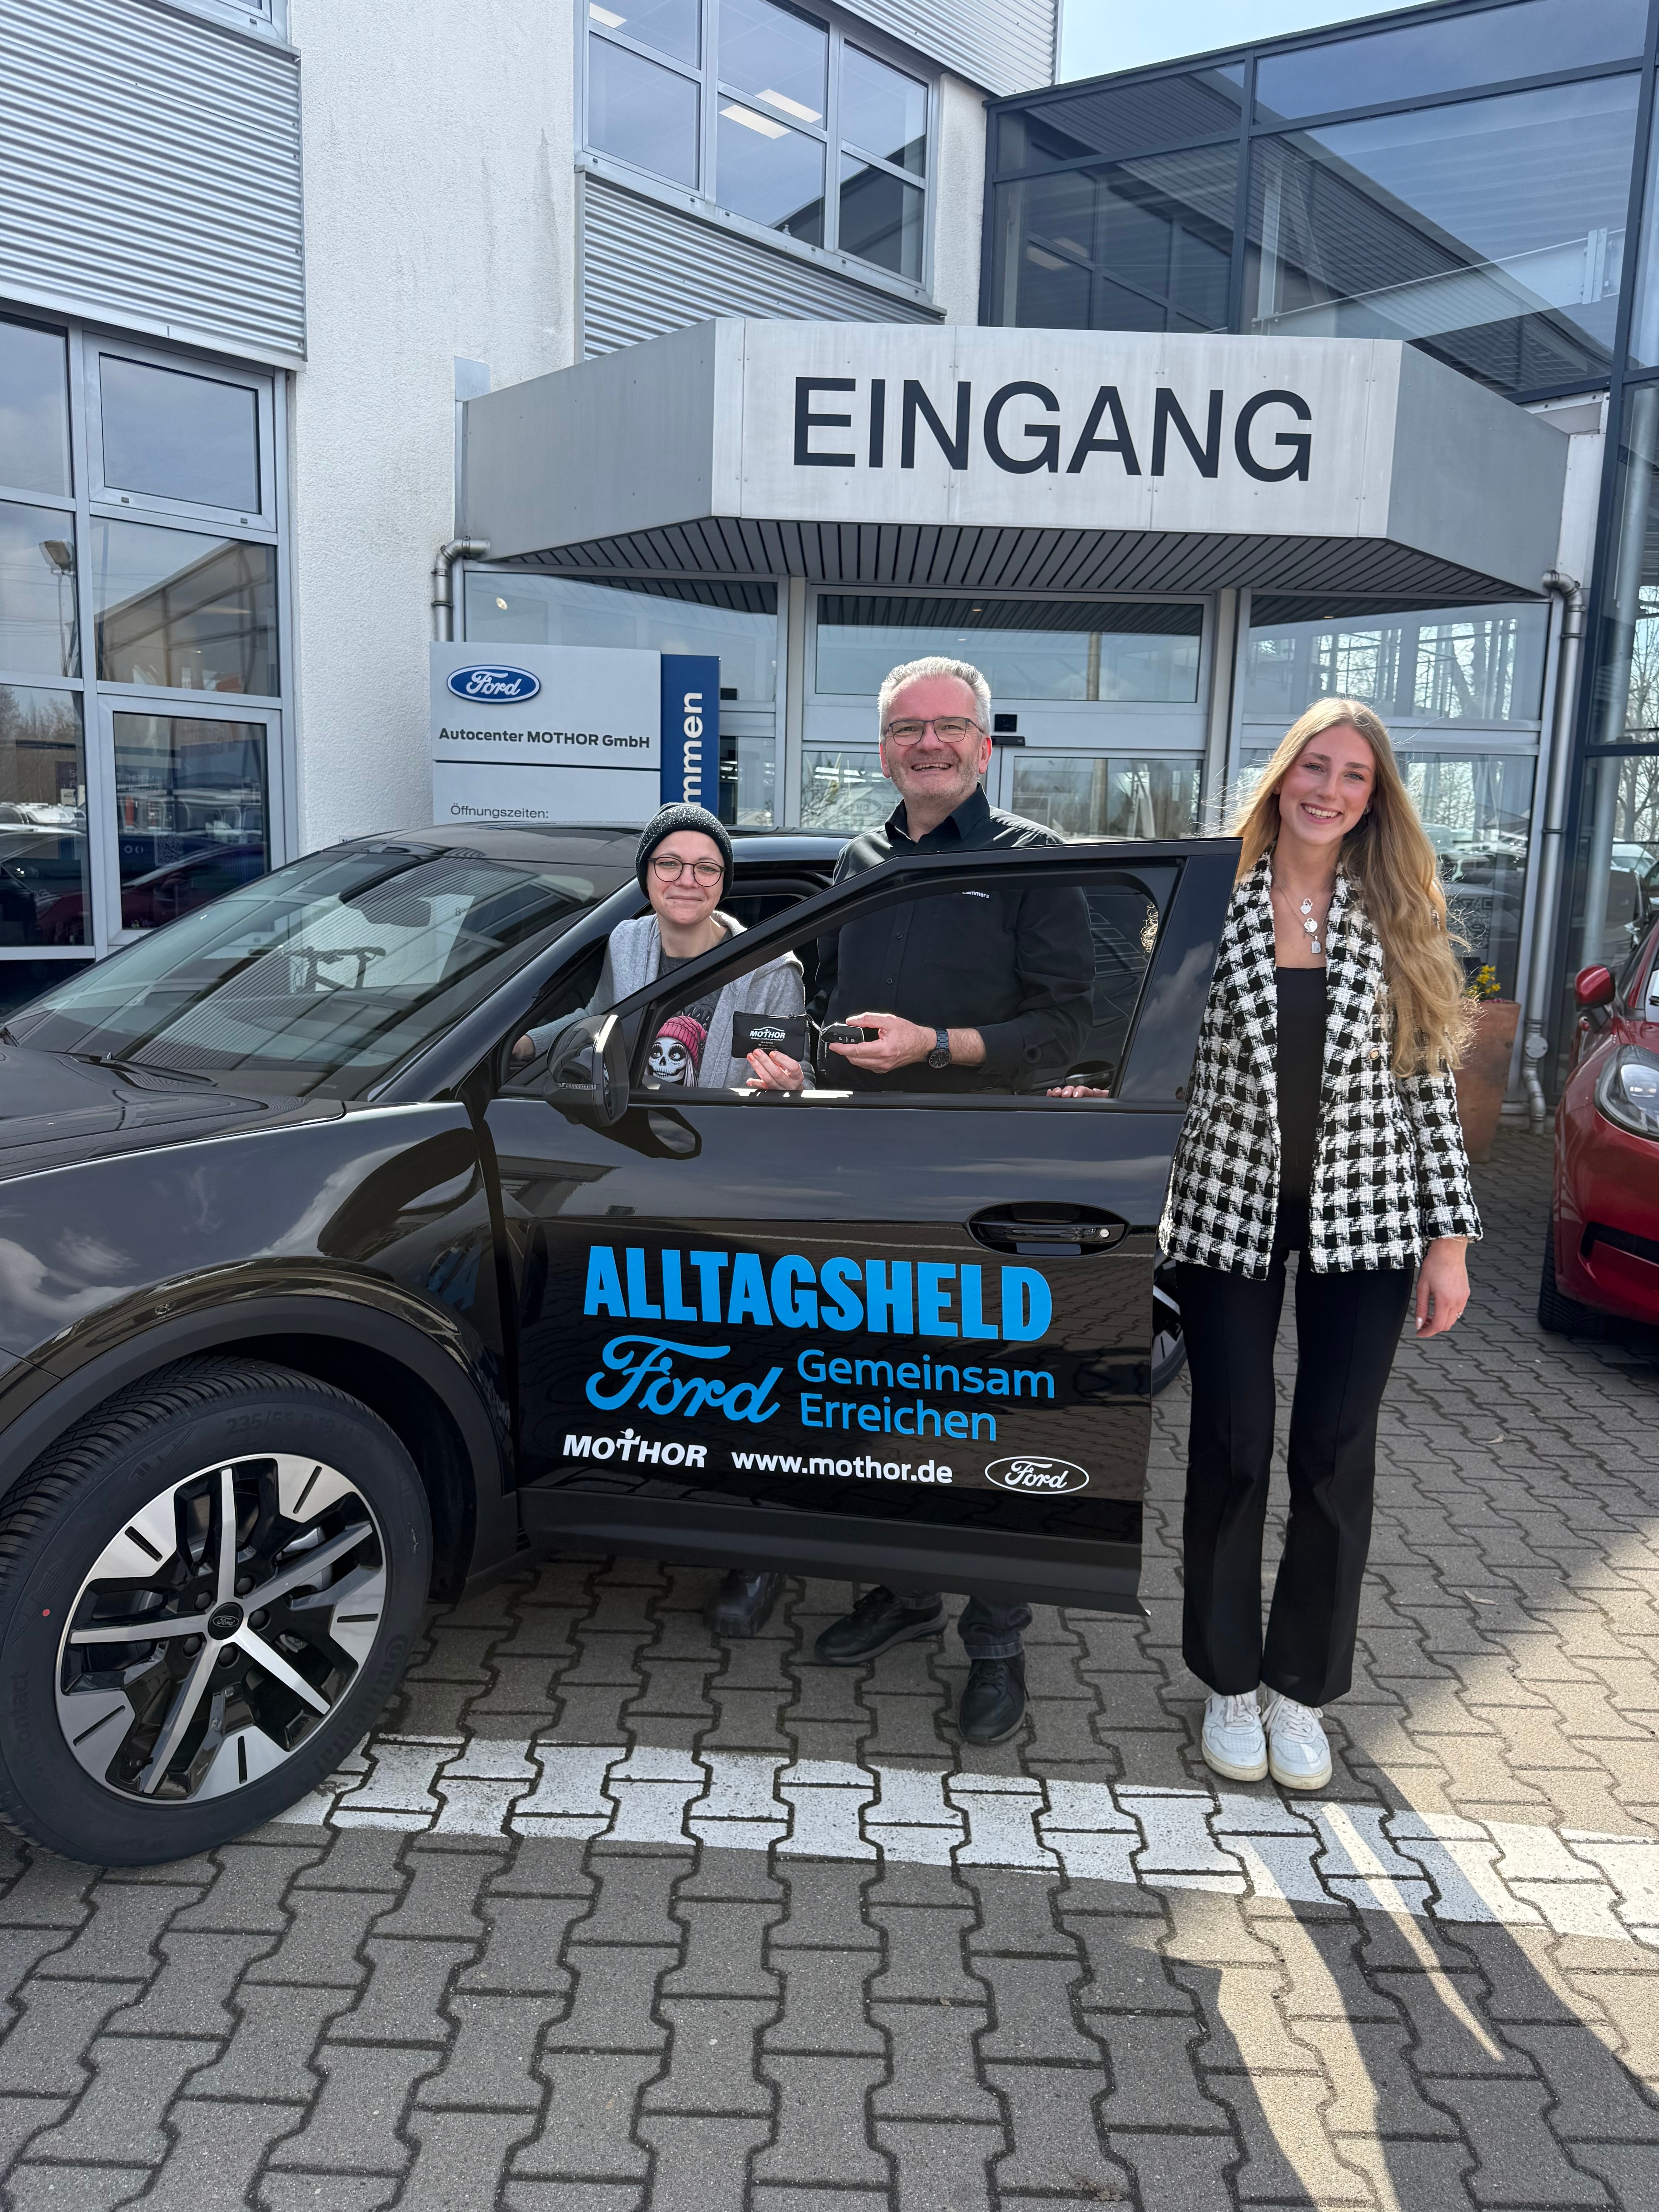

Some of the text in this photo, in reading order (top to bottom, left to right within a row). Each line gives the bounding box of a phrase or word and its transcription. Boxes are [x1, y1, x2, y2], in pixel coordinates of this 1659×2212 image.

[793, 376, 1312, 482] EINGANG
[466, 671, 521, 696] Ford
[439, 728, 650, 748] Autocenter MOTHOR GmbH
[450, 803, 549, 819] Öffnungszeiten:
[749, 1029, 786, 1039] MOTHOR
[584, 1245, 1053, 1341] ALLTAGSHELD
[585, 1334, 783, 1423] Ford
[797, 1349, 1055, 1398] Gemeinsam
[800, 1393, 996, 1441] Erreichen
[563, 1429, 953, 1484] MOTHOR www.mothor.de
[1005, 1460, 1068, 1490] Ford
[216, 1617, 235, 1626] Ford
